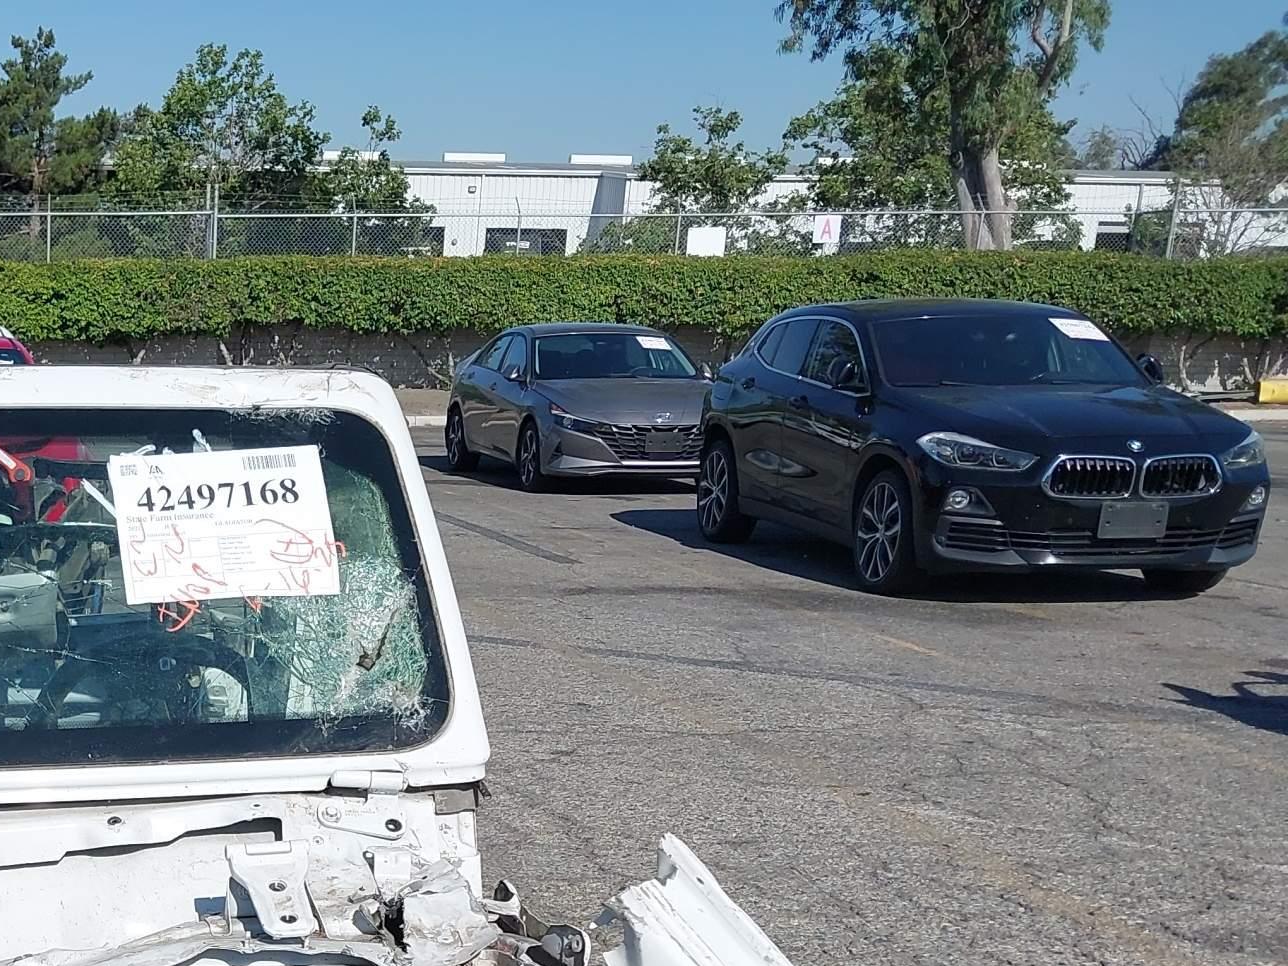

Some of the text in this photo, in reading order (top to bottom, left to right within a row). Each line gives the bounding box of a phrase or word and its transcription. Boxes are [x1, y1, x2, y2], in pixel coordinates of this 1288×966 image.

[820, 217, 832, 240] A
[137, 478, 299, 512] 42497168
[126, 512, 214, 524] State Farm Insurance
